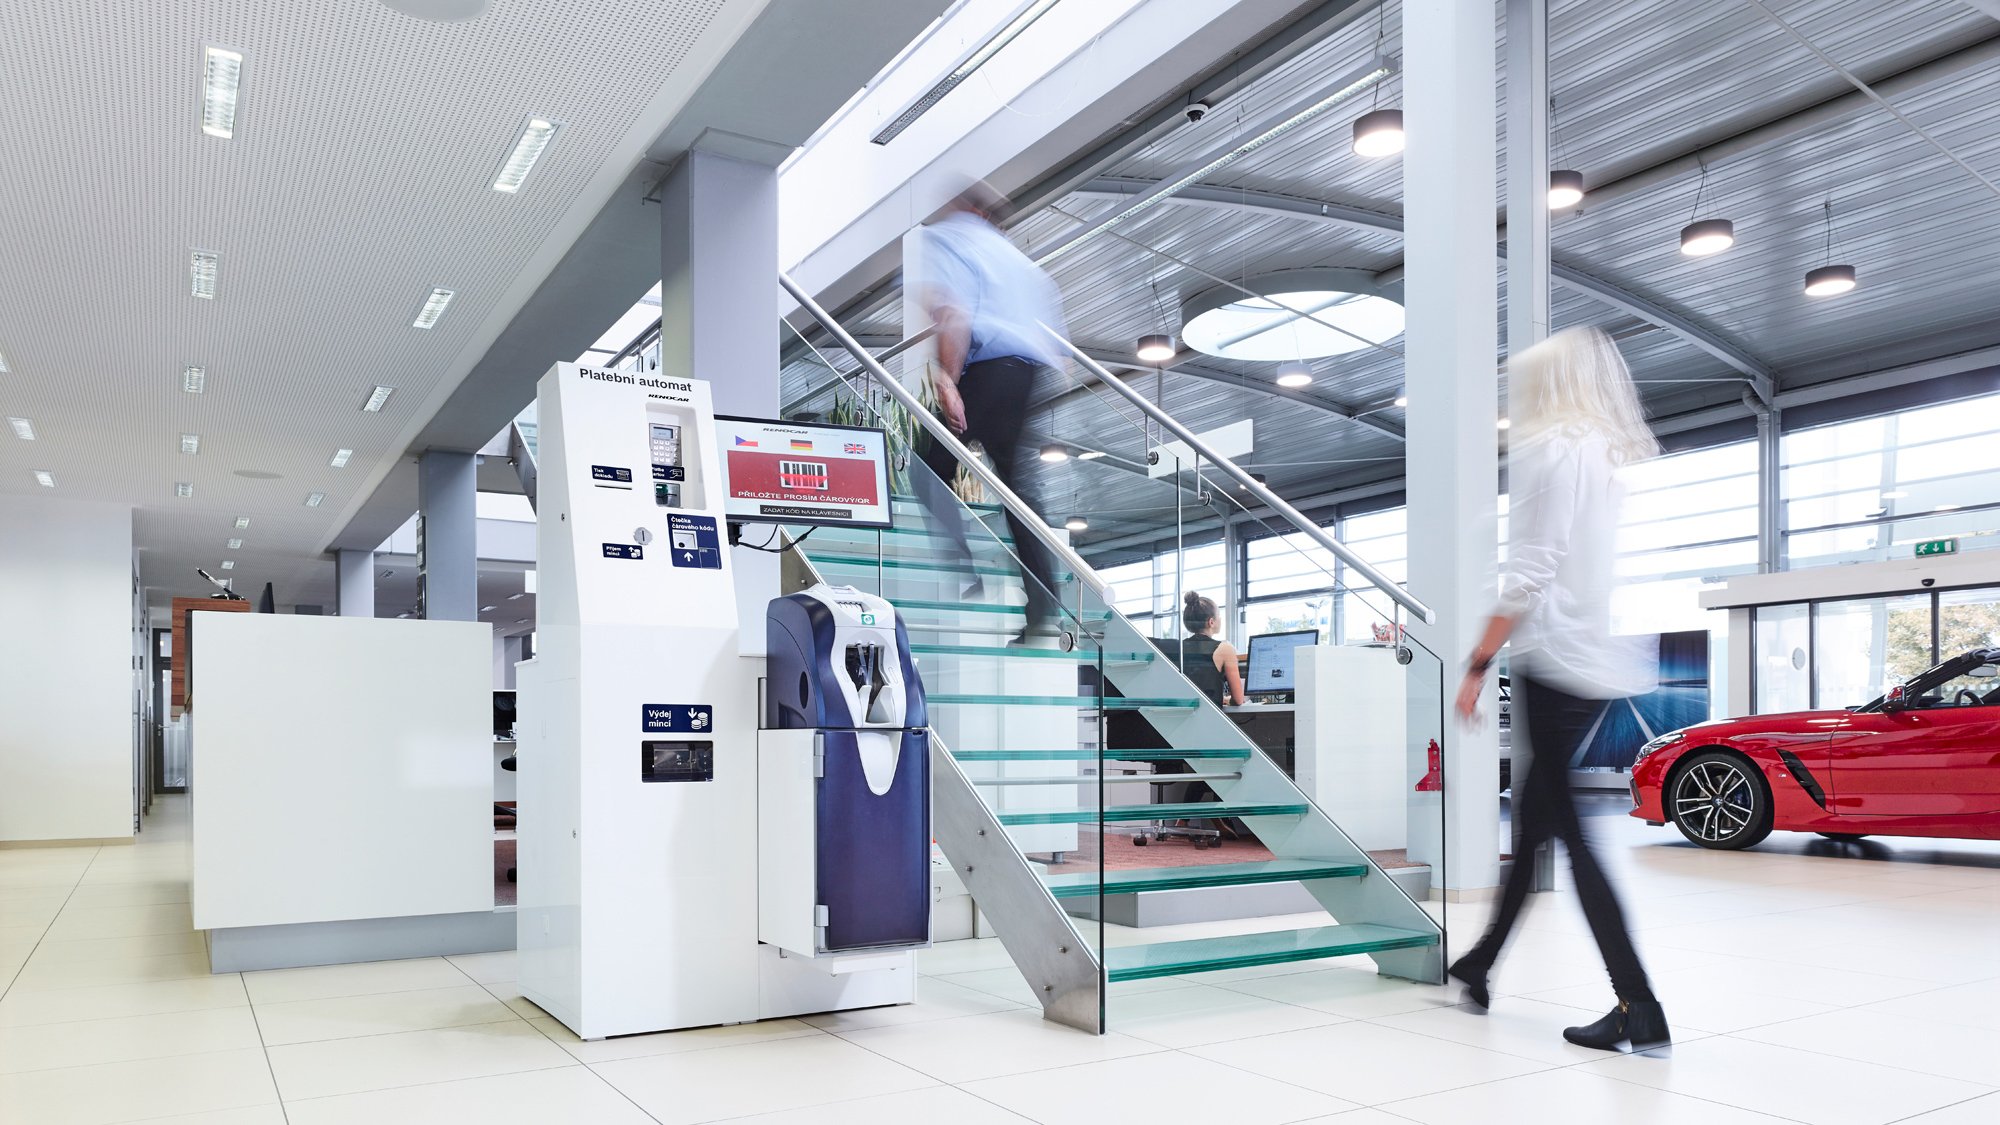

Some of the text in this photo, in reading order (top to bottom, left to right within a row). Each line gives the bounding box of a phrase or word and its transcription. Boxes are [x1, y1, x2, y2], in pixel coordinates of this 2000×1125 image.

[580, 368, 692, 392] Platební automat
[648, 394, 690, 402] RENOCAR
[738, 491, 781, 500] PŘILOŽTE
[784, 493, 818, 502] PROSÍM
[648, 710, 671, 719] Výdej
